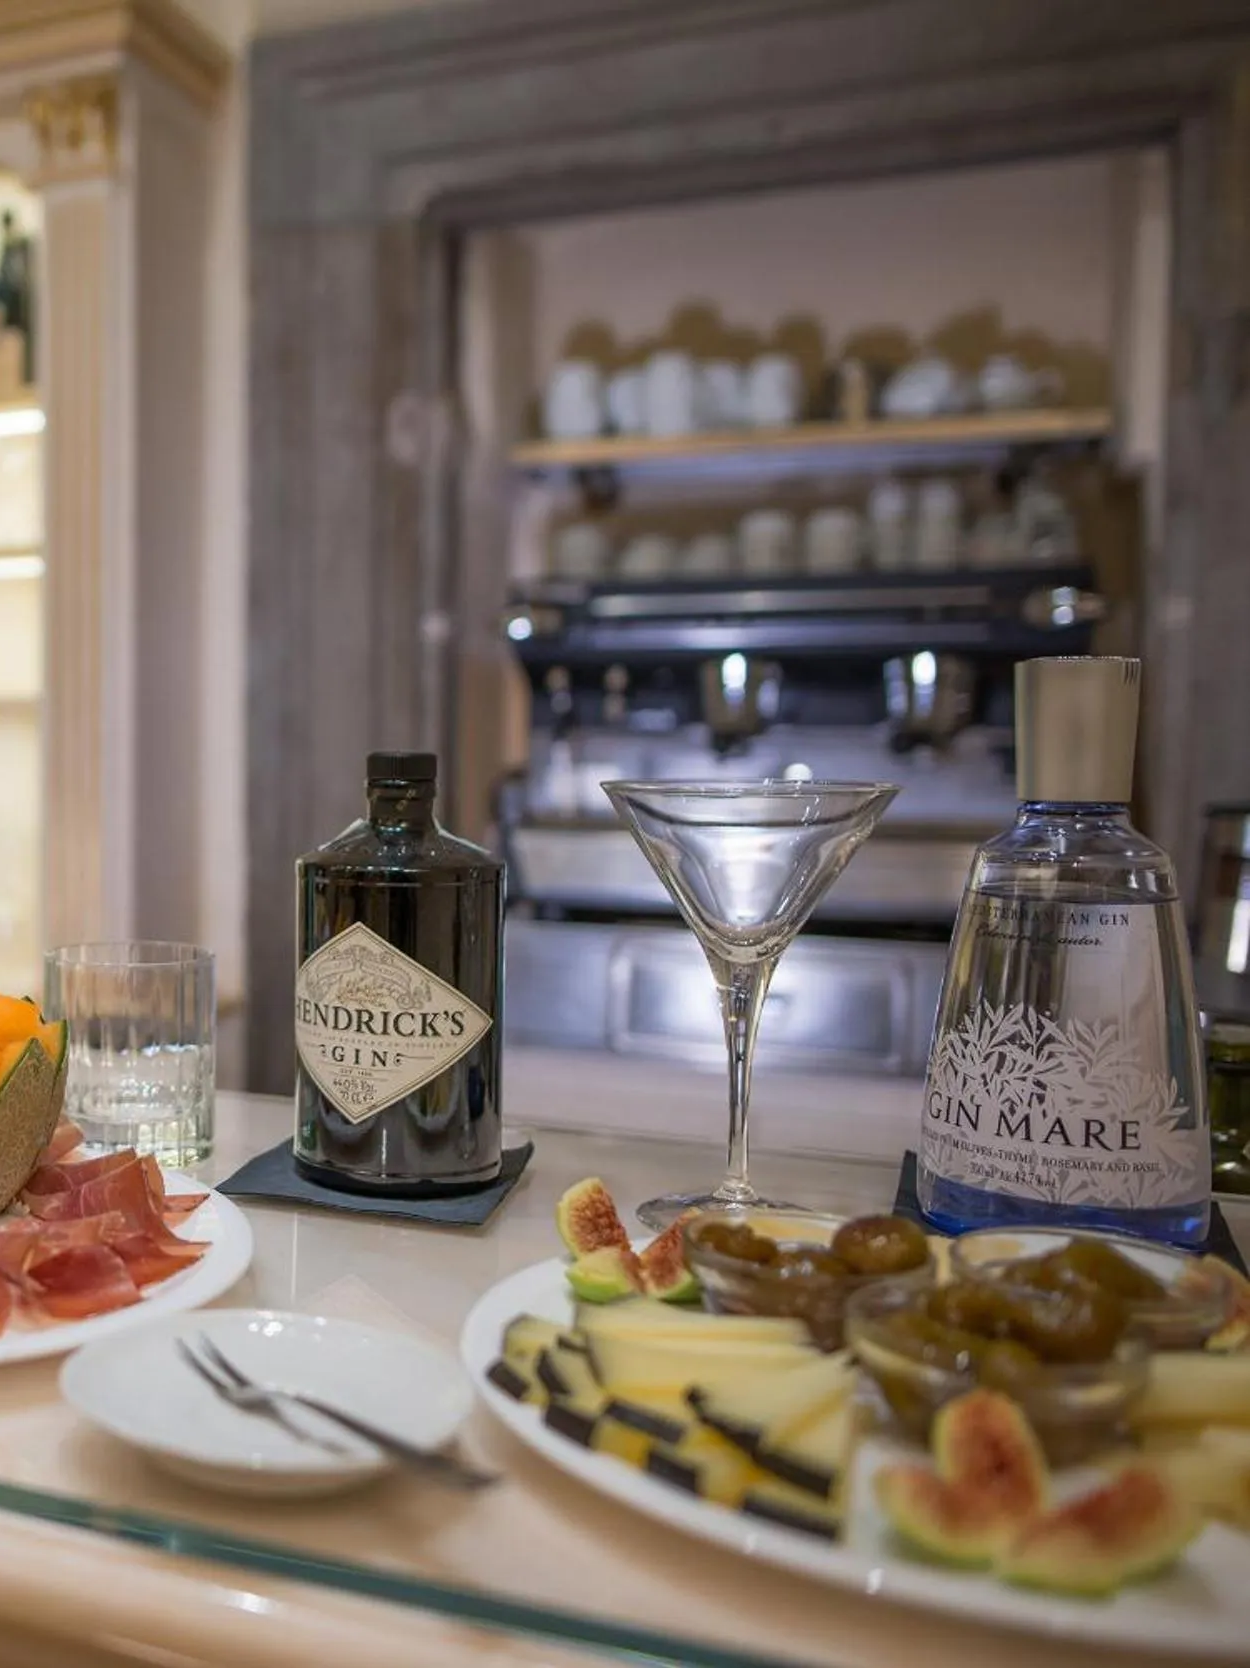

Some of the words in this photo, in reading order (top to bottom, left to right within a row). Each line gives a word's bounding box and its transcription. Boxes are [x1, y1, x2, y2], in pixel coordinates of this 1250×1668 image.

[1099, 911, 1130, 926] GIN
[331, 1045, 388, 1067] GIN
[929, 1091, 982, 1131] GIN
[994, 1110, 1141, 1152] MARE
